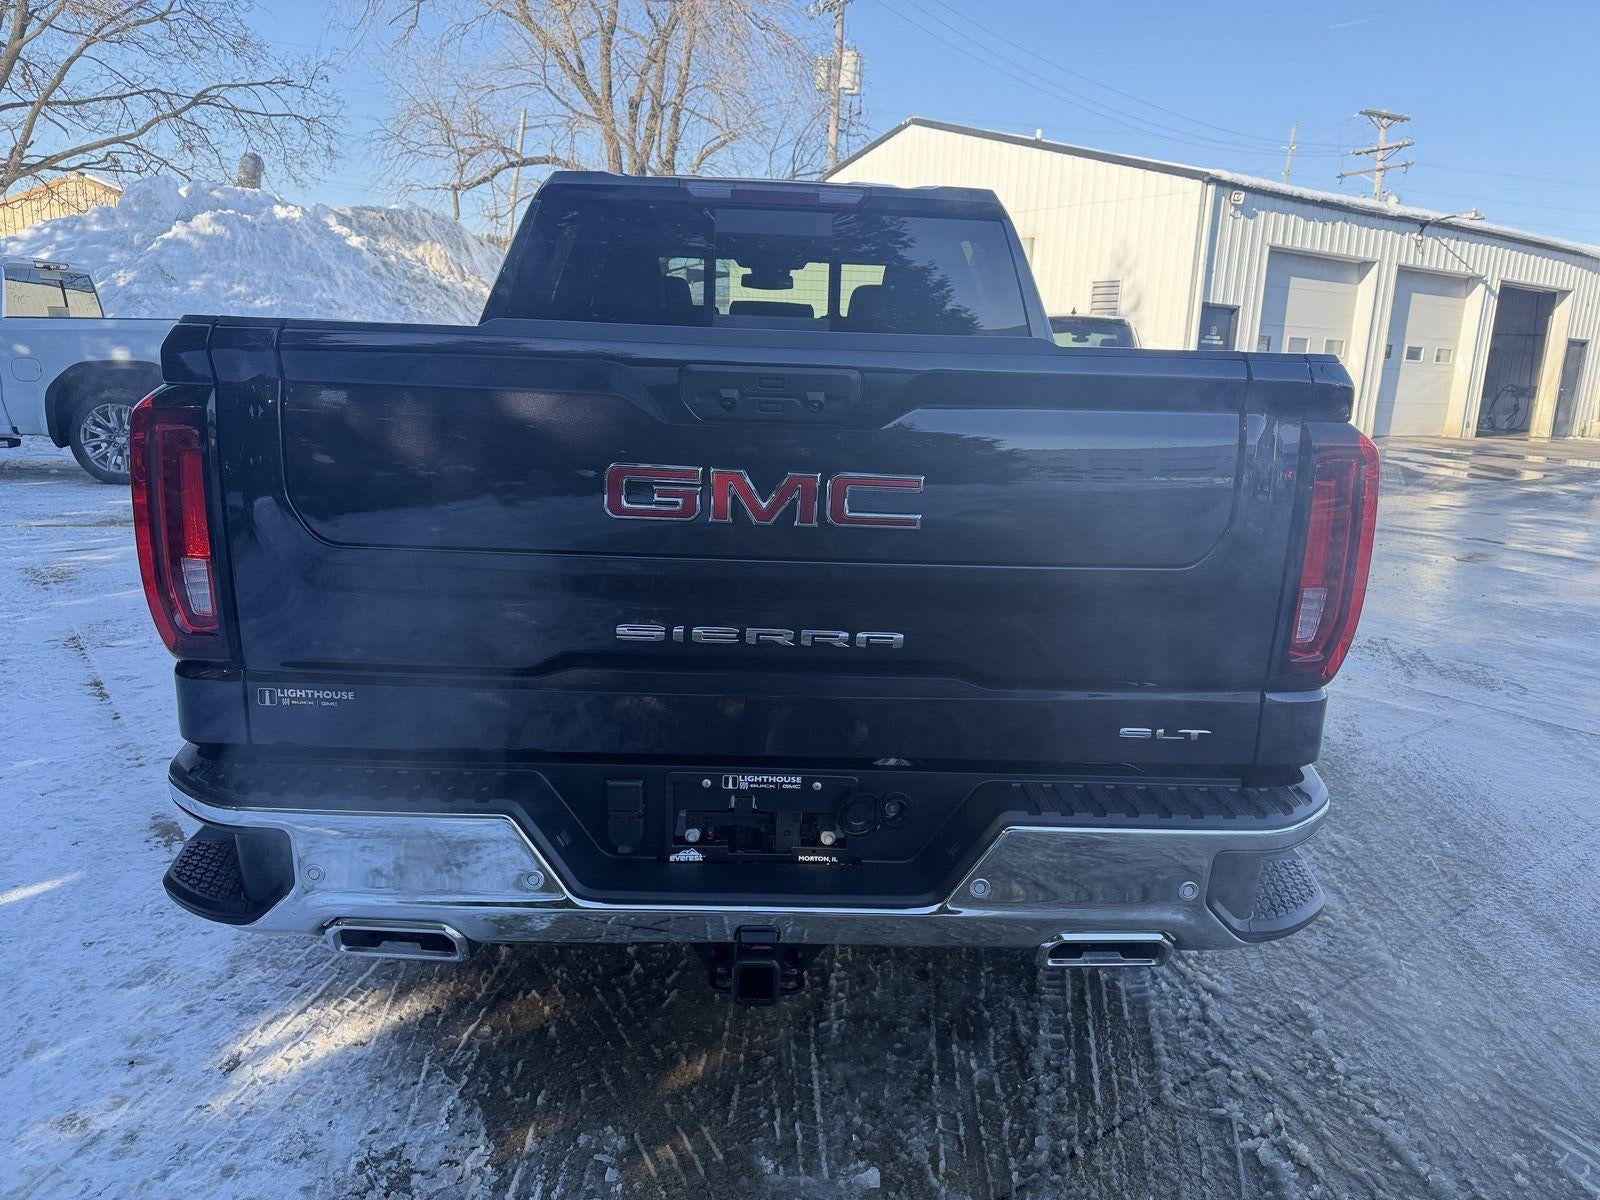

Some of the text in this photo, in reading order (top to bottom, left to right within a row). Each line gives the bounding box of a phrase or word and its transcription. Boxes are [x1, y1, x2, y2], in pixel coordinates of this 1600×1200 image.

[604, 462, 925, 529] GMC
[615, 623, 905, 649] SIERRA
[277, 688, 355, 700] LIGHTHOUSE
[1119, 727, 1212, 740] SLT
[739, 775, 802, 784] LIGHTHOUSE
[669, 853, 704, 862] everest
[798, 855, 830, 863] MORTON,
